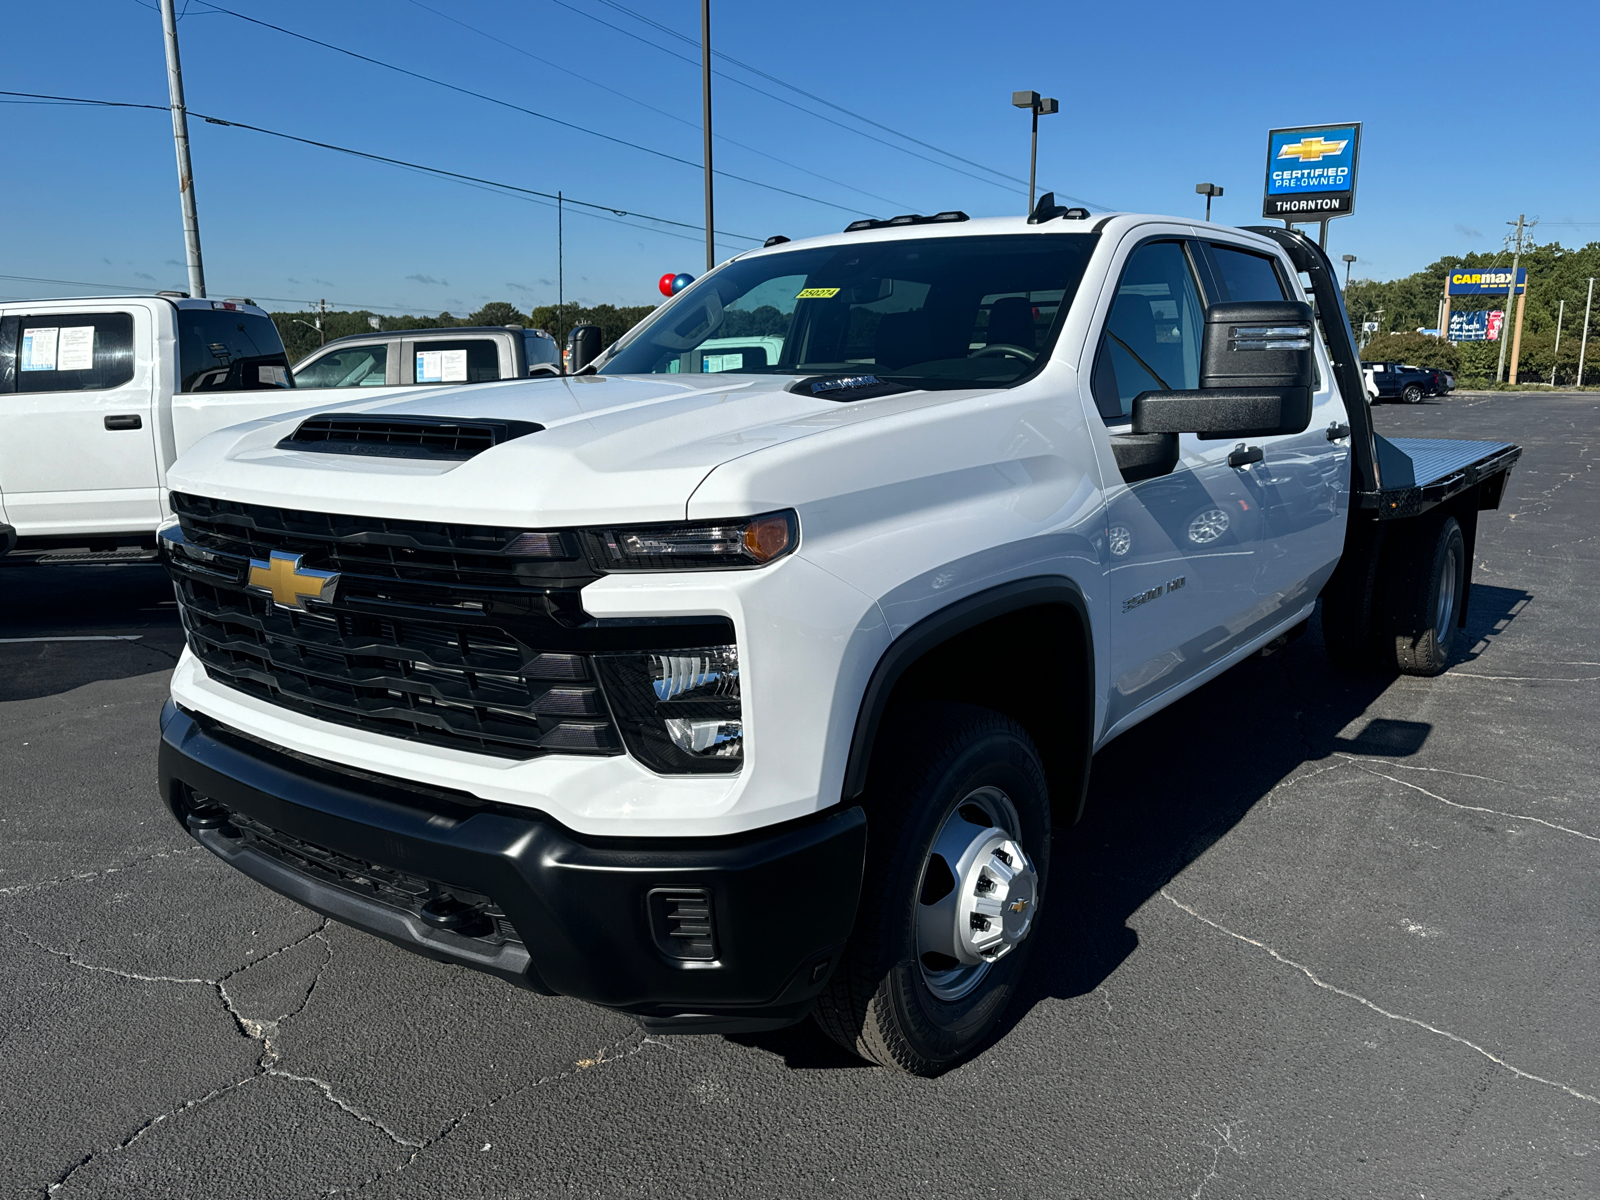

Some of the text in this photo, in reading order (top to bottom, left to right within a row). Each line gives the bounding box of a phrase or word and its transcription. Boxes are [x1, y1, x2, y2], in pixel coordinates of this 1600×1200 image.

[1273, 167, 1348, 180] CERTIFIED
[1276, 176, 1343, 188] PRE-OWNED
[1276, 199, 1340, 211] THORNTON
[1122, 574, 1186, 614] 3500 HD
